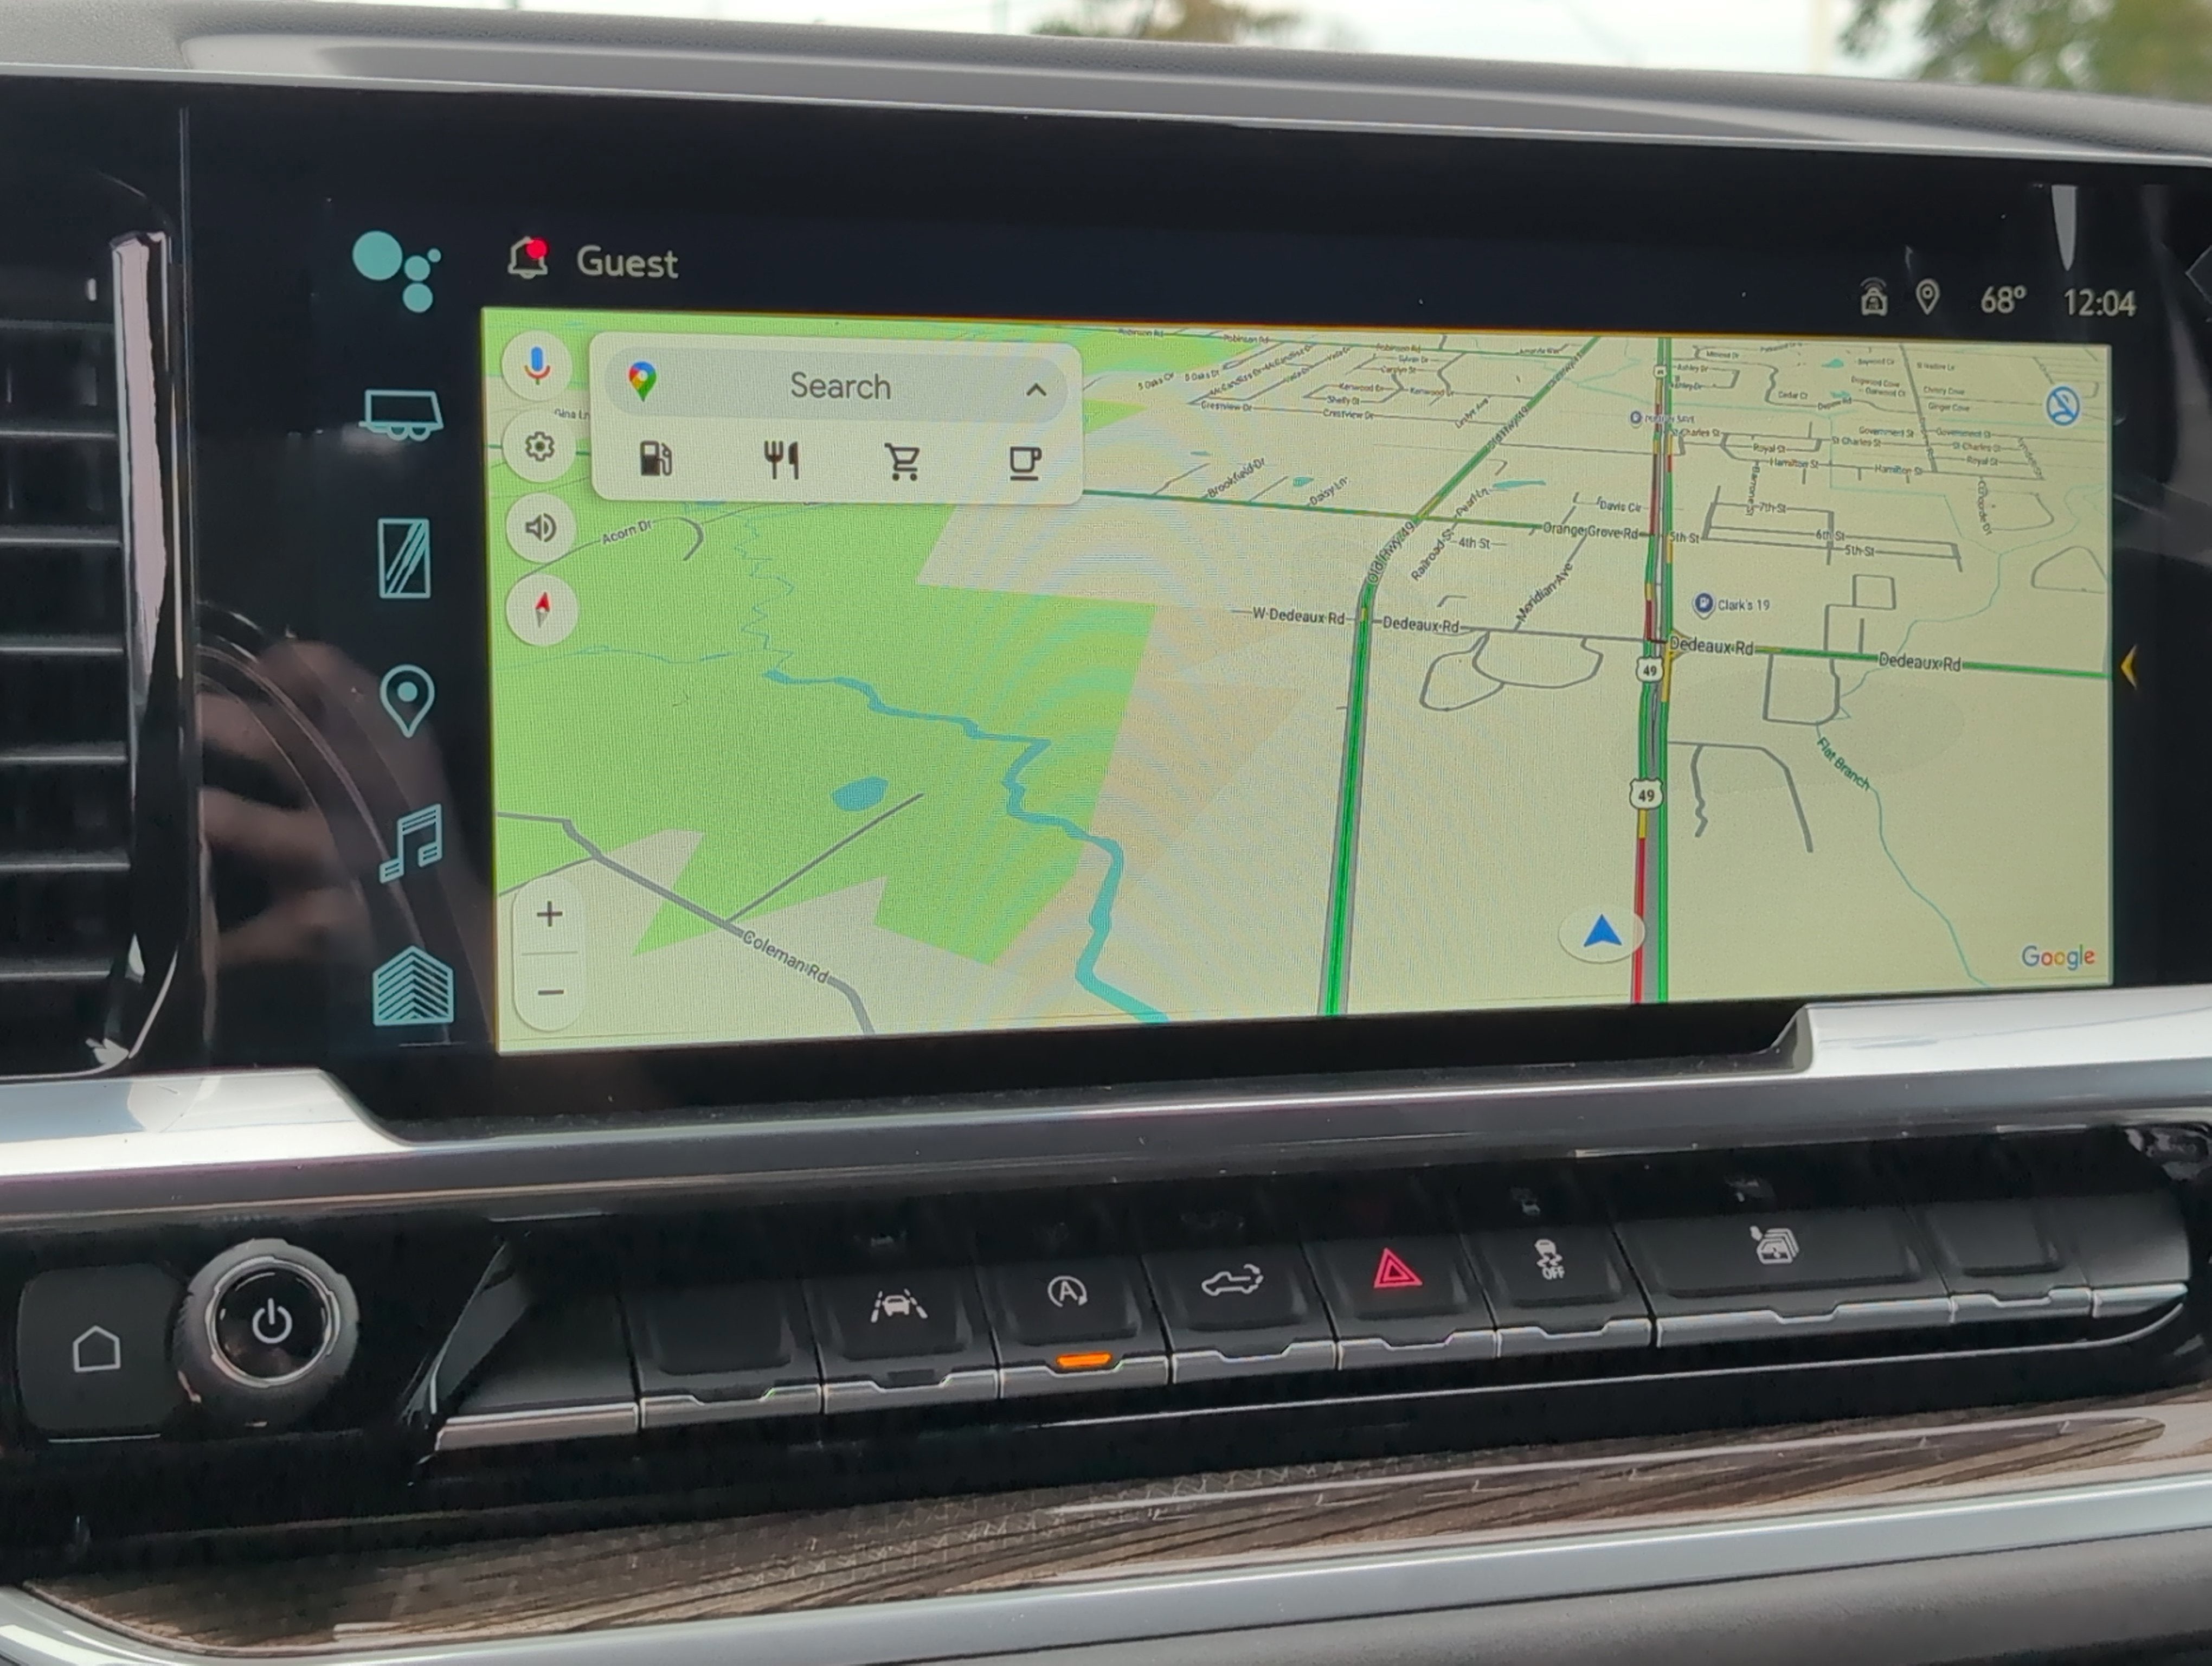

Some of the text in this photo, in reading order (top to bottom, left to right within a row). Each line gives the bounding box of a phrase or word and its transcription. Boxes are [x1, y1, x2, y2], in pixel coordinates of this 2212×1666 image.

[577, 245, 679, 279] Guest
[2064, 289, 2136, 317] 12:04
[790, 371, 892, 400] Search
[1928, 401, 1951, 412] Ginger
[1323, 408, 1363, 420] Crestview
[1681, 428, 1710, 437] Charles
[1859, 426, 1905, 437] Government
[1936, 427, 1982, 438] Government
[1841, 437, 1872, 446] Charles
[1873, 438, 1881, 447] St
[1962, 441, 1992, 451] Charles
[1753, 443, 1776, 456] Royal
[1966, 454, 1989, 467] Royal
[1207, 462, 1255, 498] Brookfield
[1309, 486, 1335, 507] Daisy
[1599, 500, 1626, 512] Davis
[1758, 502, 1787, 514] 7th St
[601, 525, 638, 545] Acorn
[1544, 522, 1639, 540] Orange Grove Rd
[1669, 531, 1700, 544] 5th St
[1815, 530, 1846, 542] 6th St
[1458, 536, 1491, 550] 4th St
[1844, 544, 1875, 558] 5th St
[1515, 562, 1573, 623] Meridian Ave
[1717, 599, 1770, 611] Clark's 19
[1253, 606, 1345, 624] W Dedeaux Rd
[1383, 615, 1461, 632] Dedeaux Rd
[1670, 636, 1754, 656] Dedeaux Rd
[1879, 652, 1962, 672] Dedeaux Rd
[1643, 664, 1657, 676] 49
[1817, 737, 1871, 791] Flat Branch
[1638, 790, 1656, 803] 49
[742, 930, 829, 984] Coleman Rd
[2021, 944, 2095, 971] Google
[1541, 1266, 1565, 1280] OFF
